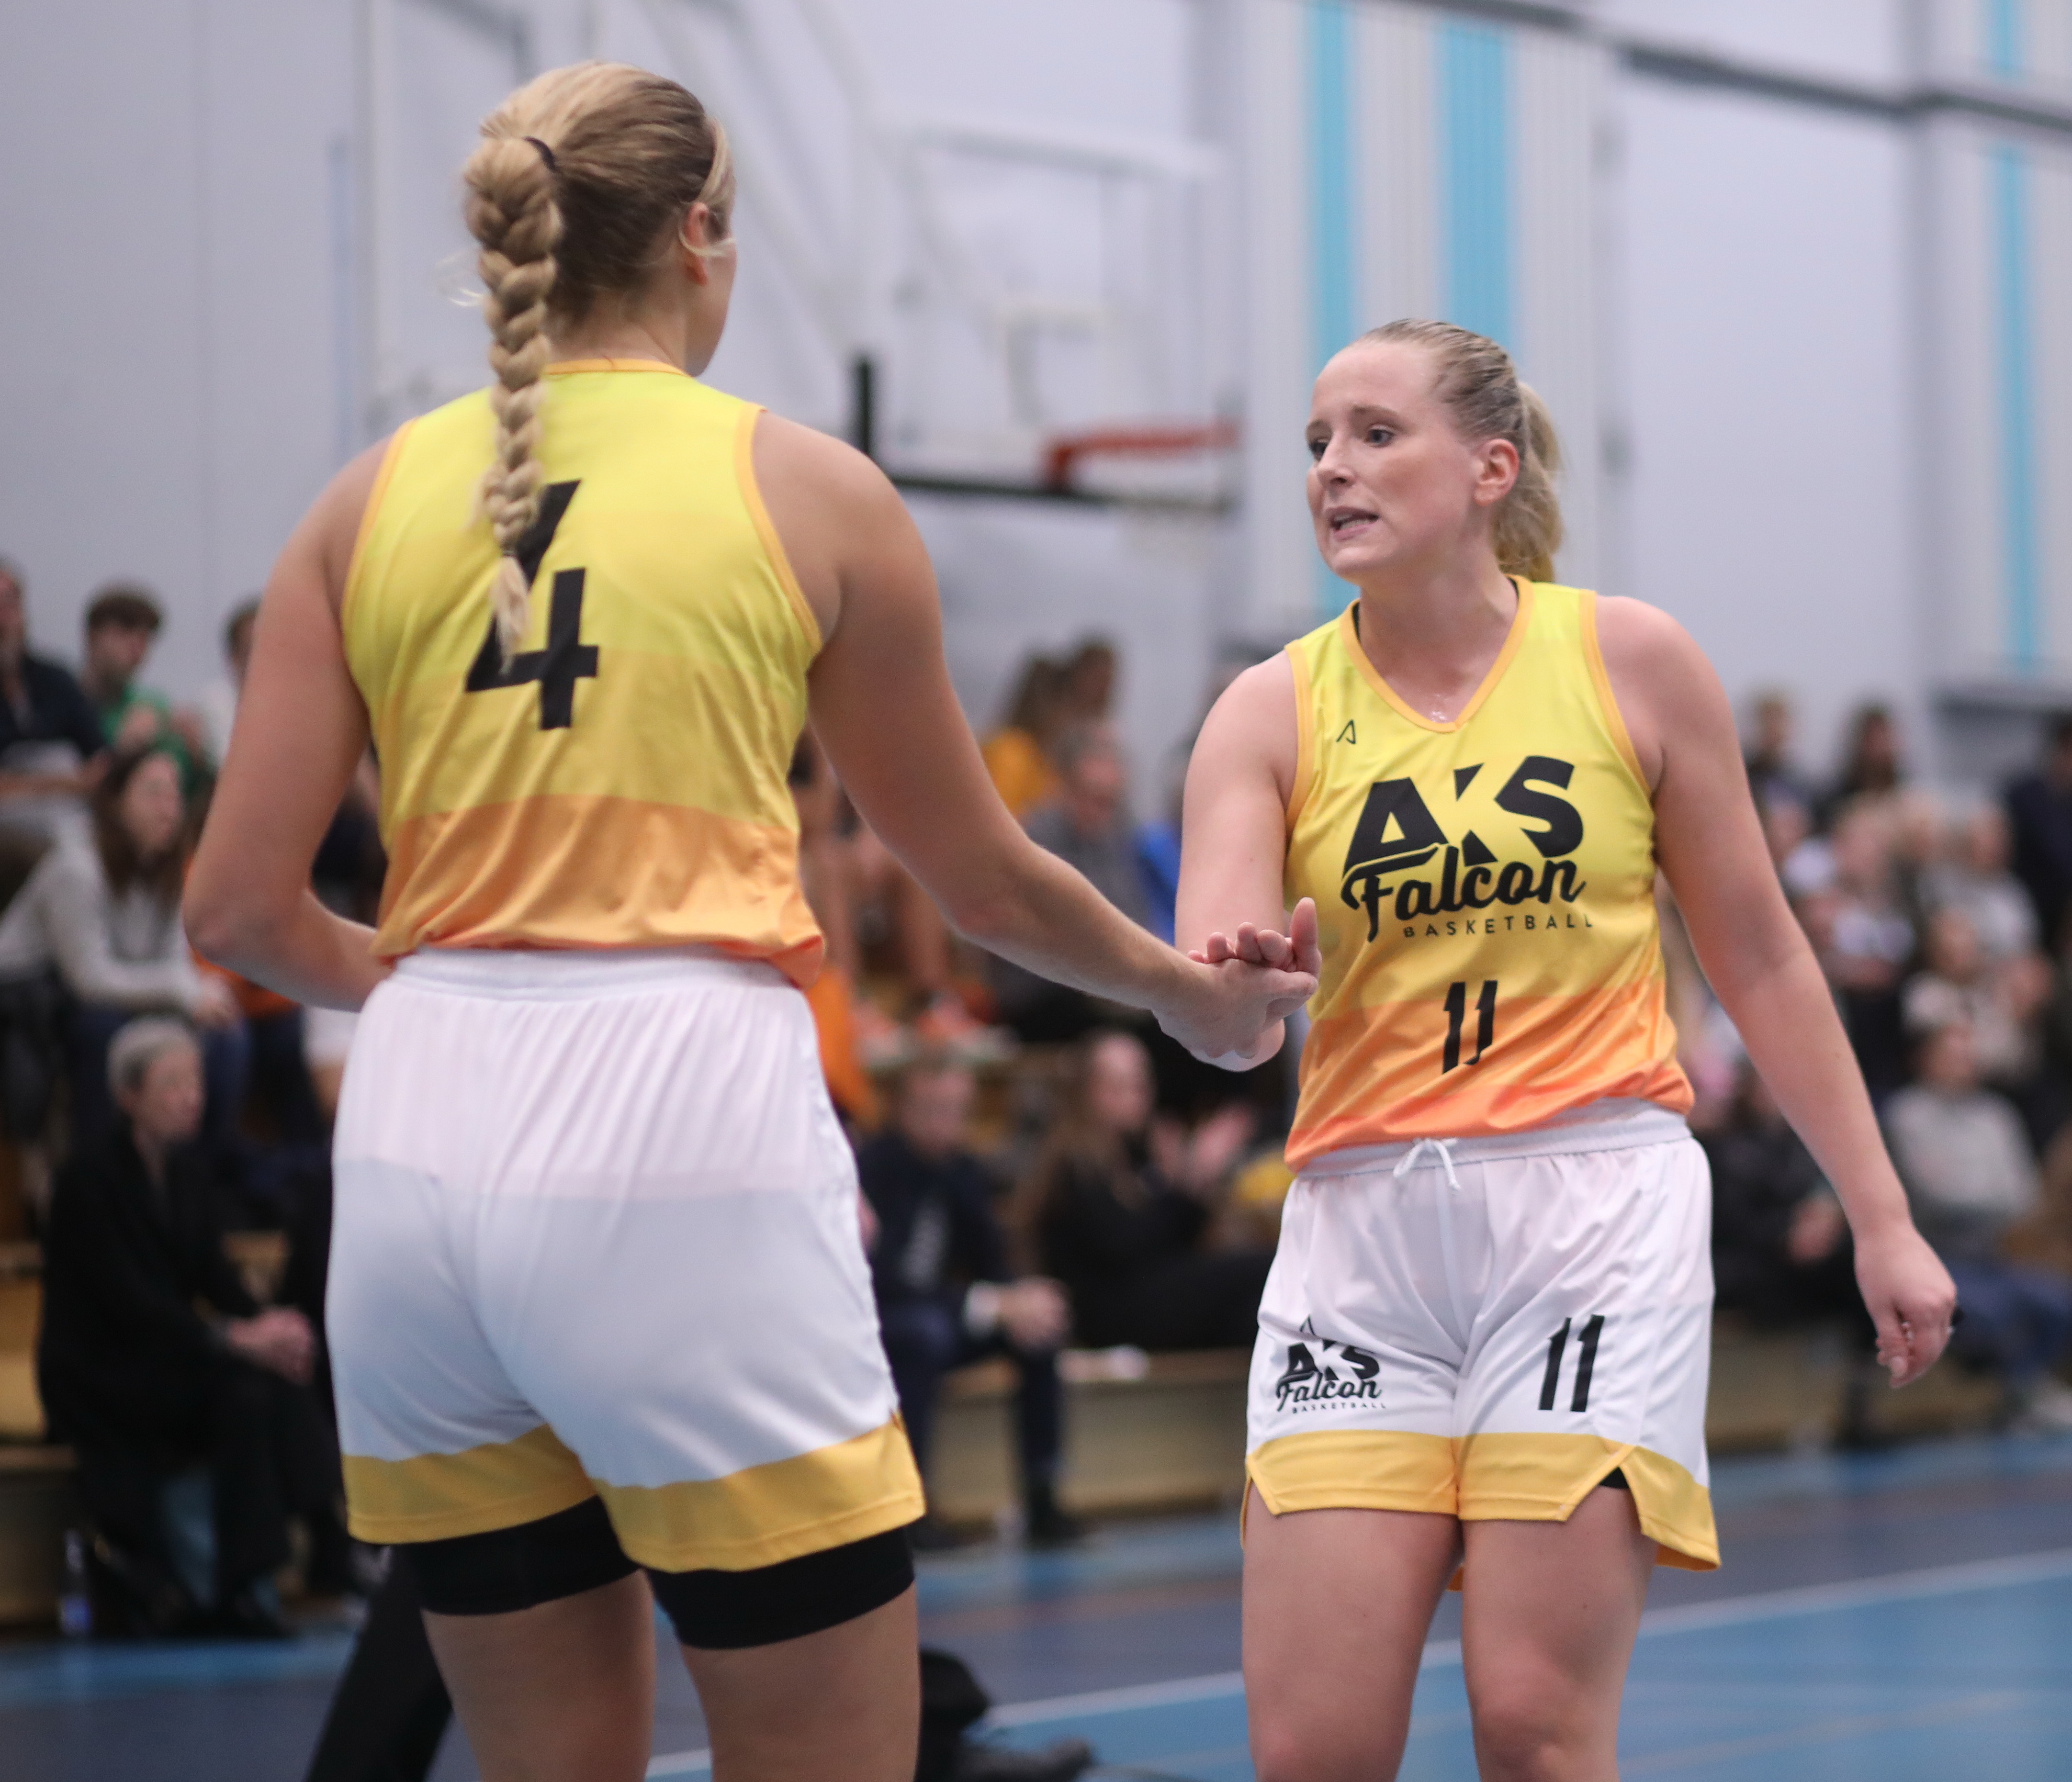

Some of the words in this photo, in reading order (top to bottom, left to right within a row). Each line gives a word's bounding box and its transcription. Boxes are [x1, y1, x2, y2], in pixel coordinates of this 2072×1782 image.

[465, 479, 599, 731] 4
[1342, 755, 1584, 879] AKS
[1341, 845, 1586, 942] Falcon
[1404, 913, 1593, 938] BASKETBALL
[1442, 980, 1498, 1075] 11
[1275, 1371, 1382, 1412] Falcon
[1279, 1339, 1380, 1381] AKS
[1538, 1314, 1605, 1412] 11
[1292, 1402, 1386, 1414] BASKETBALL
